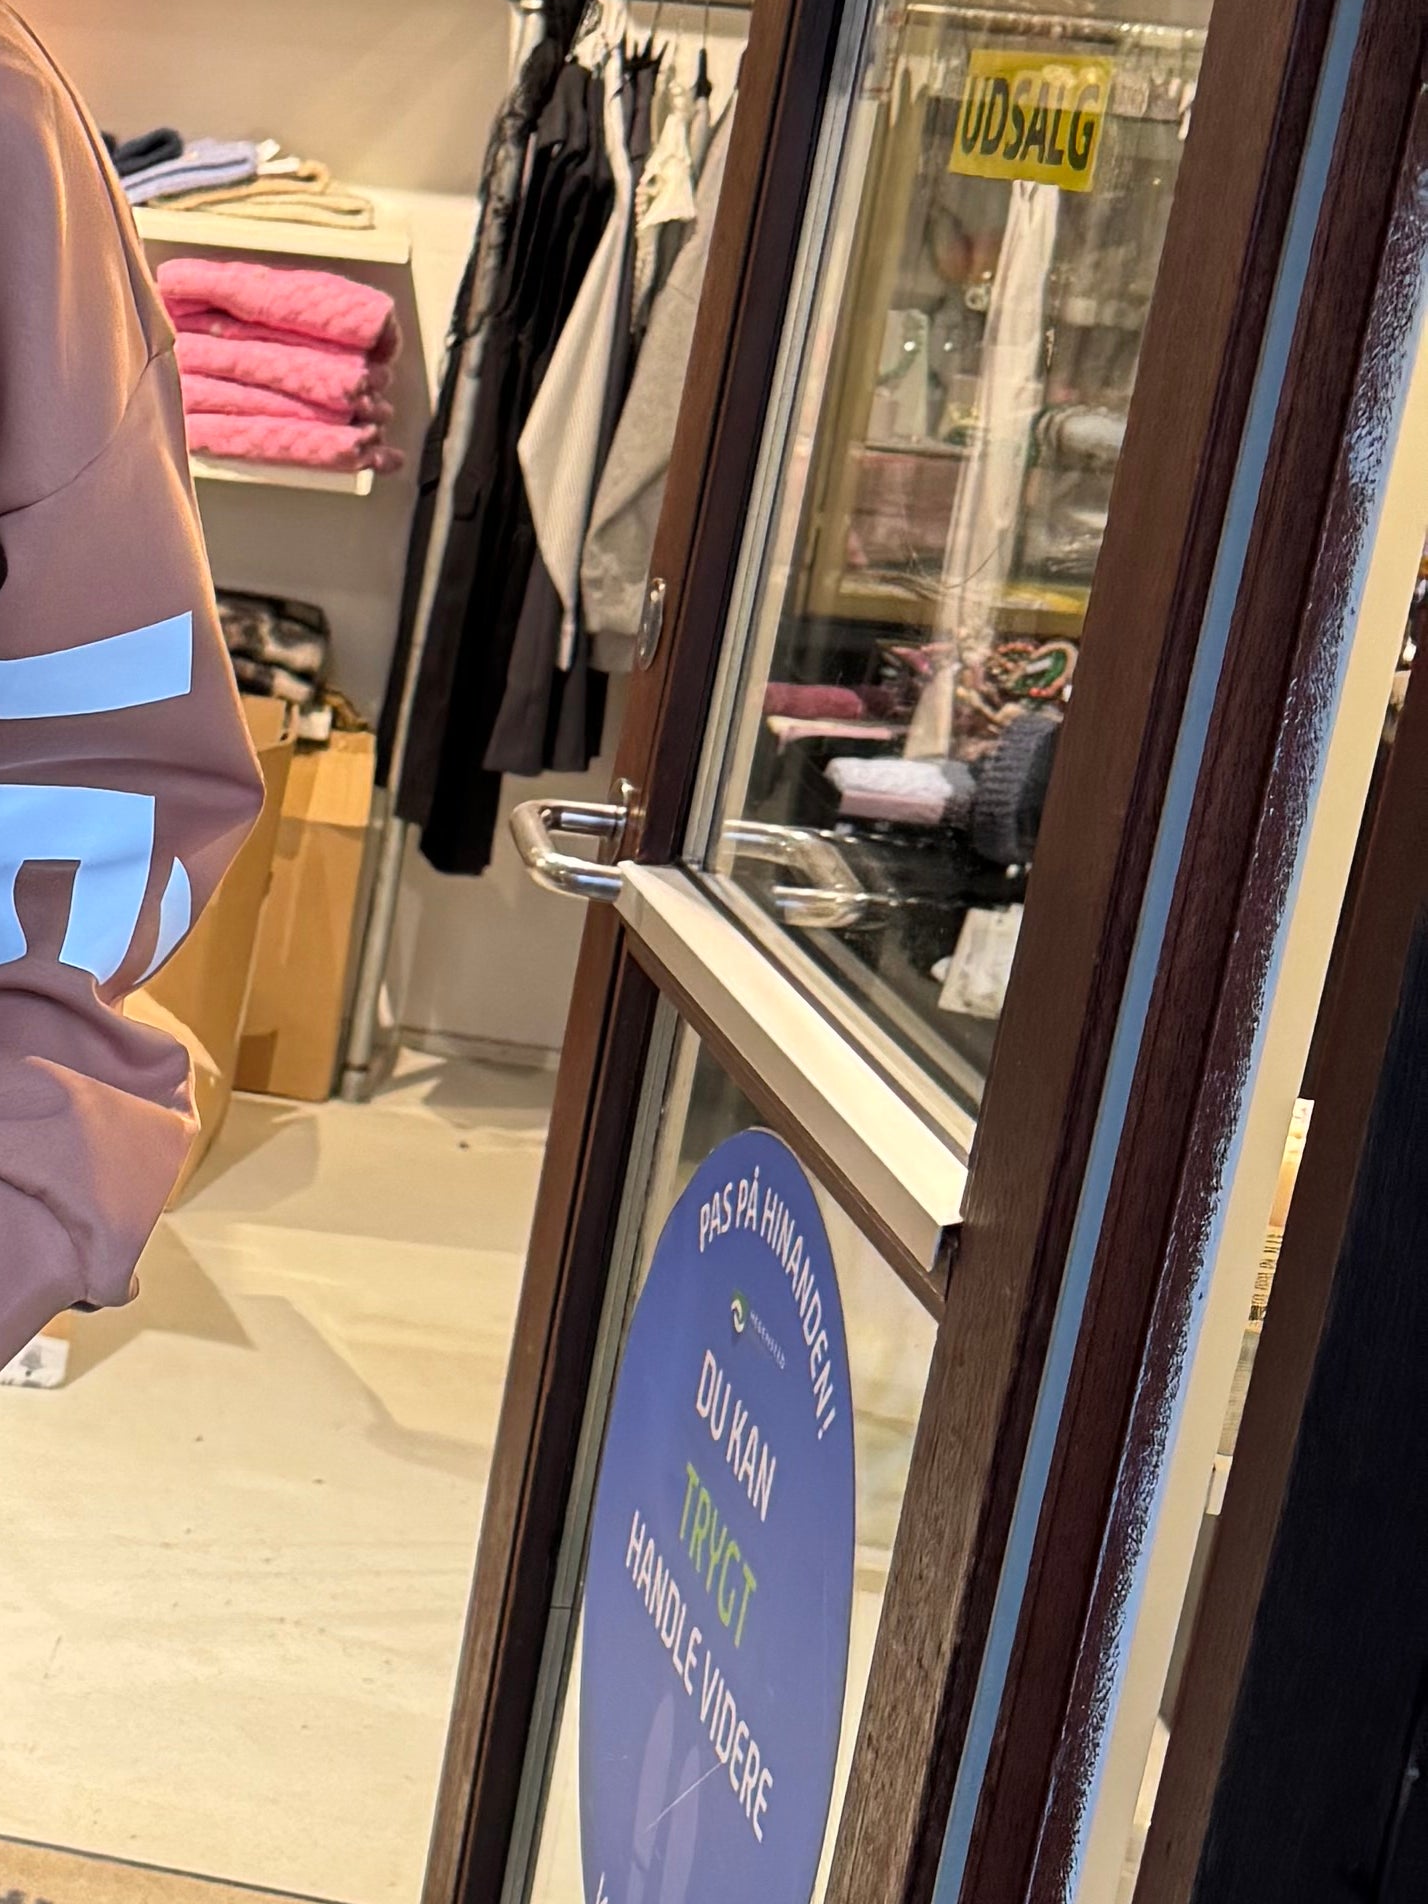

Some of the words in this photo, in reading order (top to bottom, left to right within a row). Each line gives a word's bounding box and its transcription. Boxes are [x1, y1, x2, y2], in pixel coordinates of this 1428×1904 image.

[960, 76, 1101, 172] UDSALG
[699, 1182, 734, 1254] PAS
[735, 1165, 760, 1232] PÅ
[759, 1187, 837, 1441] HINANDEN!
[695, 1349, 732, 1441] DU
[726, 1399, 777, 1524] KAN
[677, 1460, 758, 1649] TRYGT
[625, 1509, 703, 1696] HANDLE
[698, 1650, 775, 1844] VIDERE
